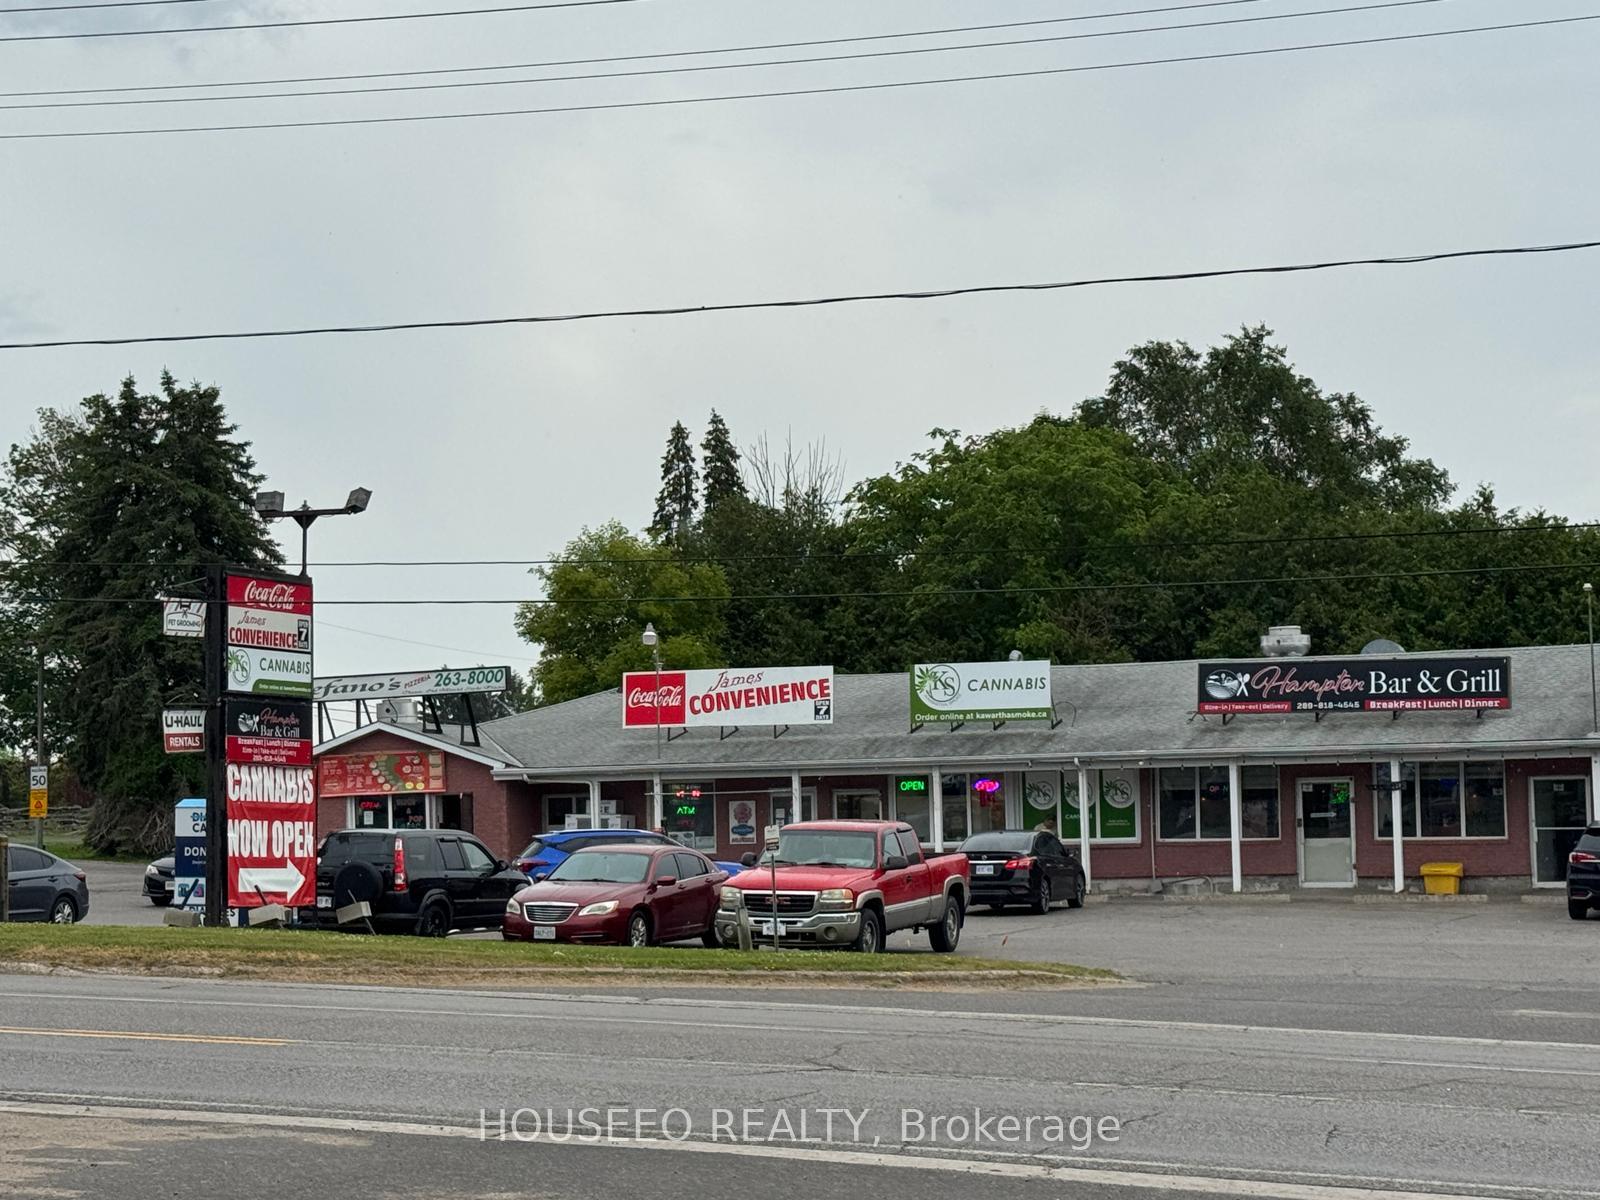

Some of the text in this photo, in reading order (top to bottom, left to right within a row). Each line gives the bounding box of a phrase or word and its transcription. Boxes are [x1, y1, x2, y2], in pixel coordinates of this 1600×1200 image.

[237, 611, 267, 626] James
[229, 627, 298, 649] CONVENIENCE
[299, 628, 308, 641] 7
[259, 657, 311, 675] CANNABIS
[434, 668, 504, 687] 263-8000
[708, 670, 765, 693] James
[967, 677, 1047, 692] CANNABIS
[1250, 665, 1502, 701] Hampton Bar & Grill
[689, 678, 831, 716] CONVENIENCE
[1428, 699, 1458, 708] Lunch
[1464, 698, 1501, 707] Dinner
[816, 705, 829, 715] 7
[915, 713, 938, 721] Order
[940, 712, 964, 721] online
[975, 710, 1047, 720] kawarthasmoke.ca
[165, 715, 203, 728] U-HAUL
[260, 724, 273, 737] Bar
[283, 725, 300, 739] Grill
[170, 736, 200, 747] RENTALS
[32, 775, 46, 786] 50
[227, 764, 314, 804] CANNABIS
[900, 781, 925, 791] OPEN
[1209, 784, 1229, 794] OPN
[676, 805, 696, 814] ATM
[227, 819, 314, 858] NOW OPEN
